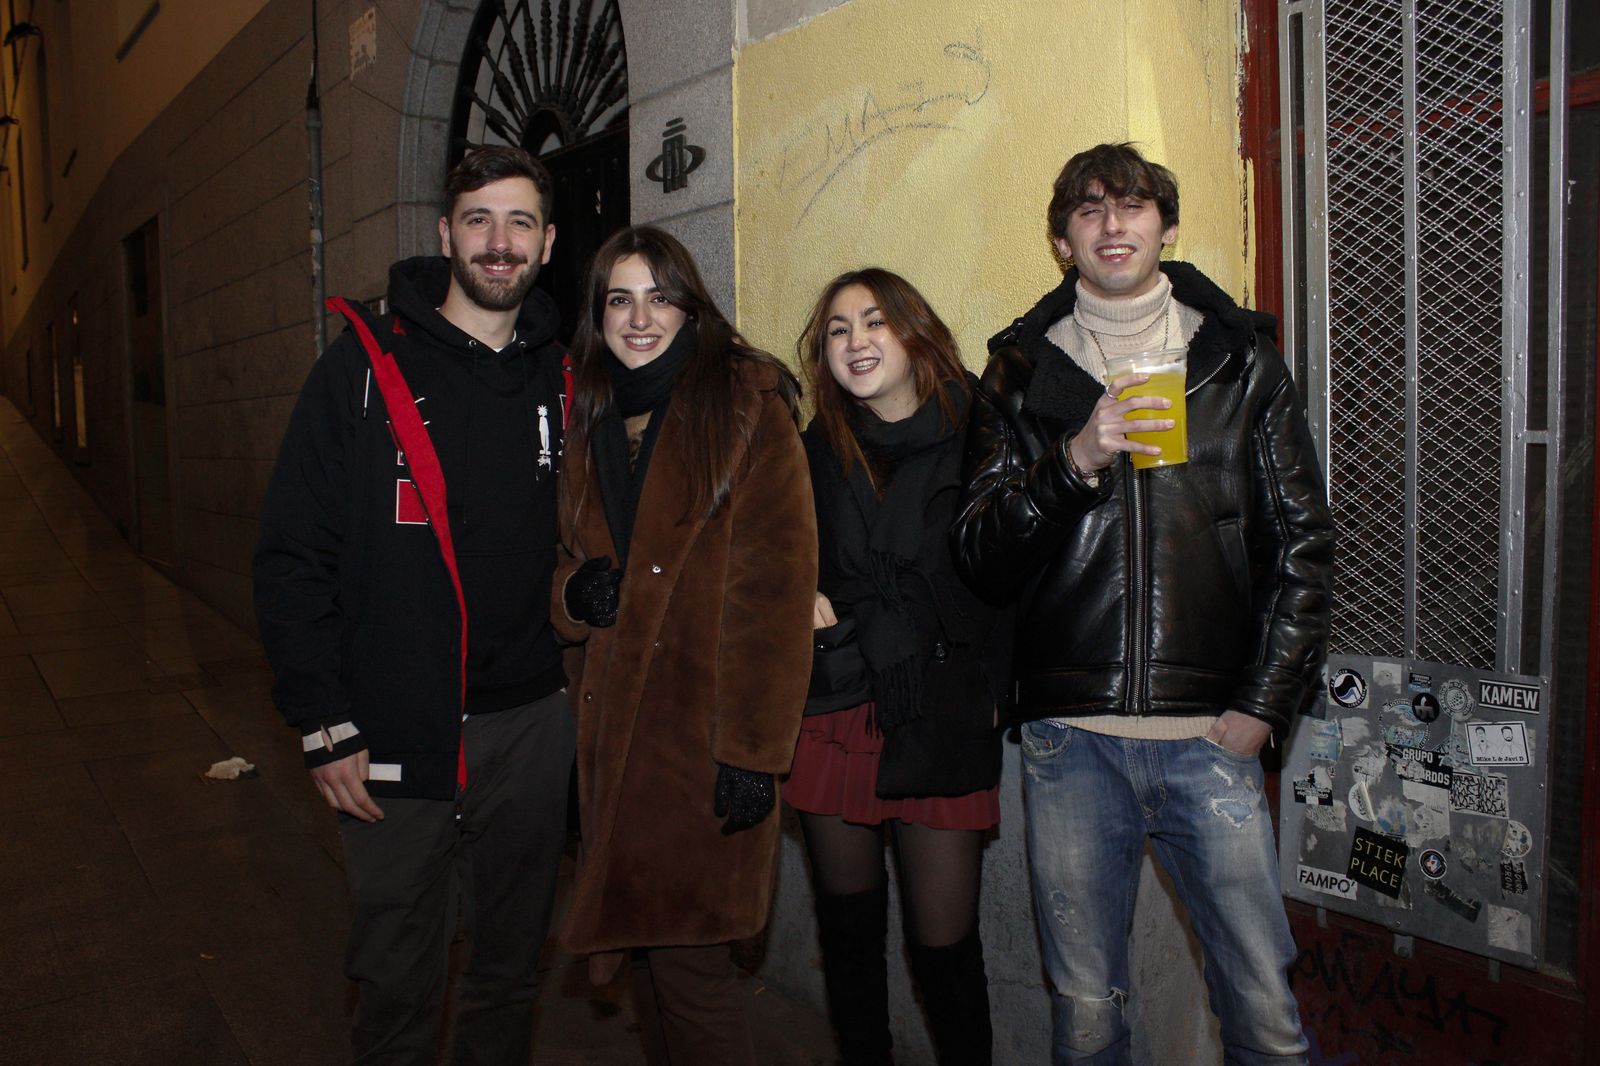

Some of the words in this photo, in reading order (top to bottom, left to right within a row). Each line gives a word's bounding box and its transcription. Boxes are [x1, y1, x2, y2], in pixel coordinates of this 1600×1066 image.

[1481, 684, 1538, 709] KAMEW
[1402, 748, 1433, 763] GRUPO
[1354, 837, 1404, 868] STIEK
[1351, 857, 1400, 888] PLACE
